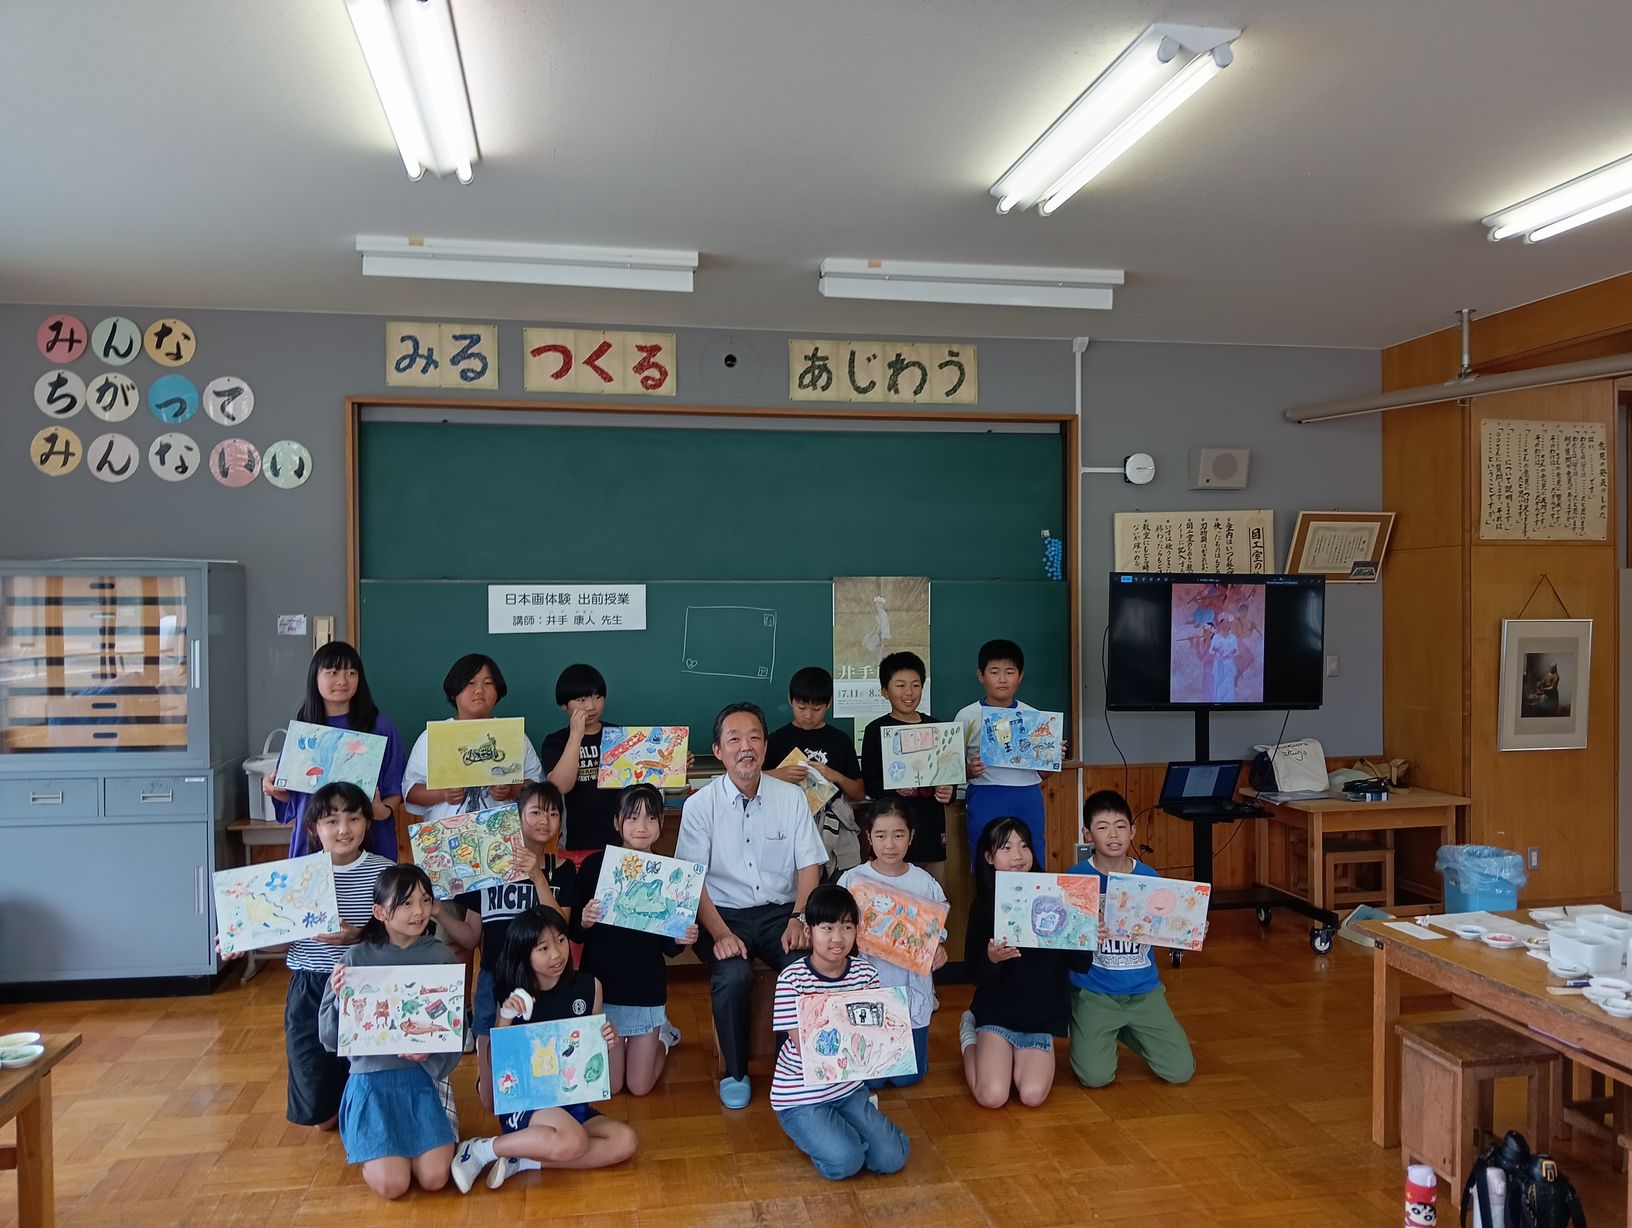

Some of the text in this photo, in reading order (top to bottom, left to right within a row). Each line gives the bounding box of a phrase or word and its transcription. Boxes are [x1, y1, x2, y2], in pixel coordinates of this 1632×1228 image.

[46, 320, 191, 361] みんな
[394, 333, 489, 382] みる
[530, 341, 669, 391] つくる
[798, 346, 967, 397] あじわう
[46, 371, 244, 422] ちがって
[39, 432, 305, 479] みんないい
[505, 592, 630, 606] 日本画体験 出前授業
[512, 614, 623, 627] 講師：井手 康人 先生
[840, 665, 880, 680] 井手
[579, 745, 599, 759] RLD
[488, 884, 539, 911] RICH
[1101, 939, 1140, 954] ALIVE
